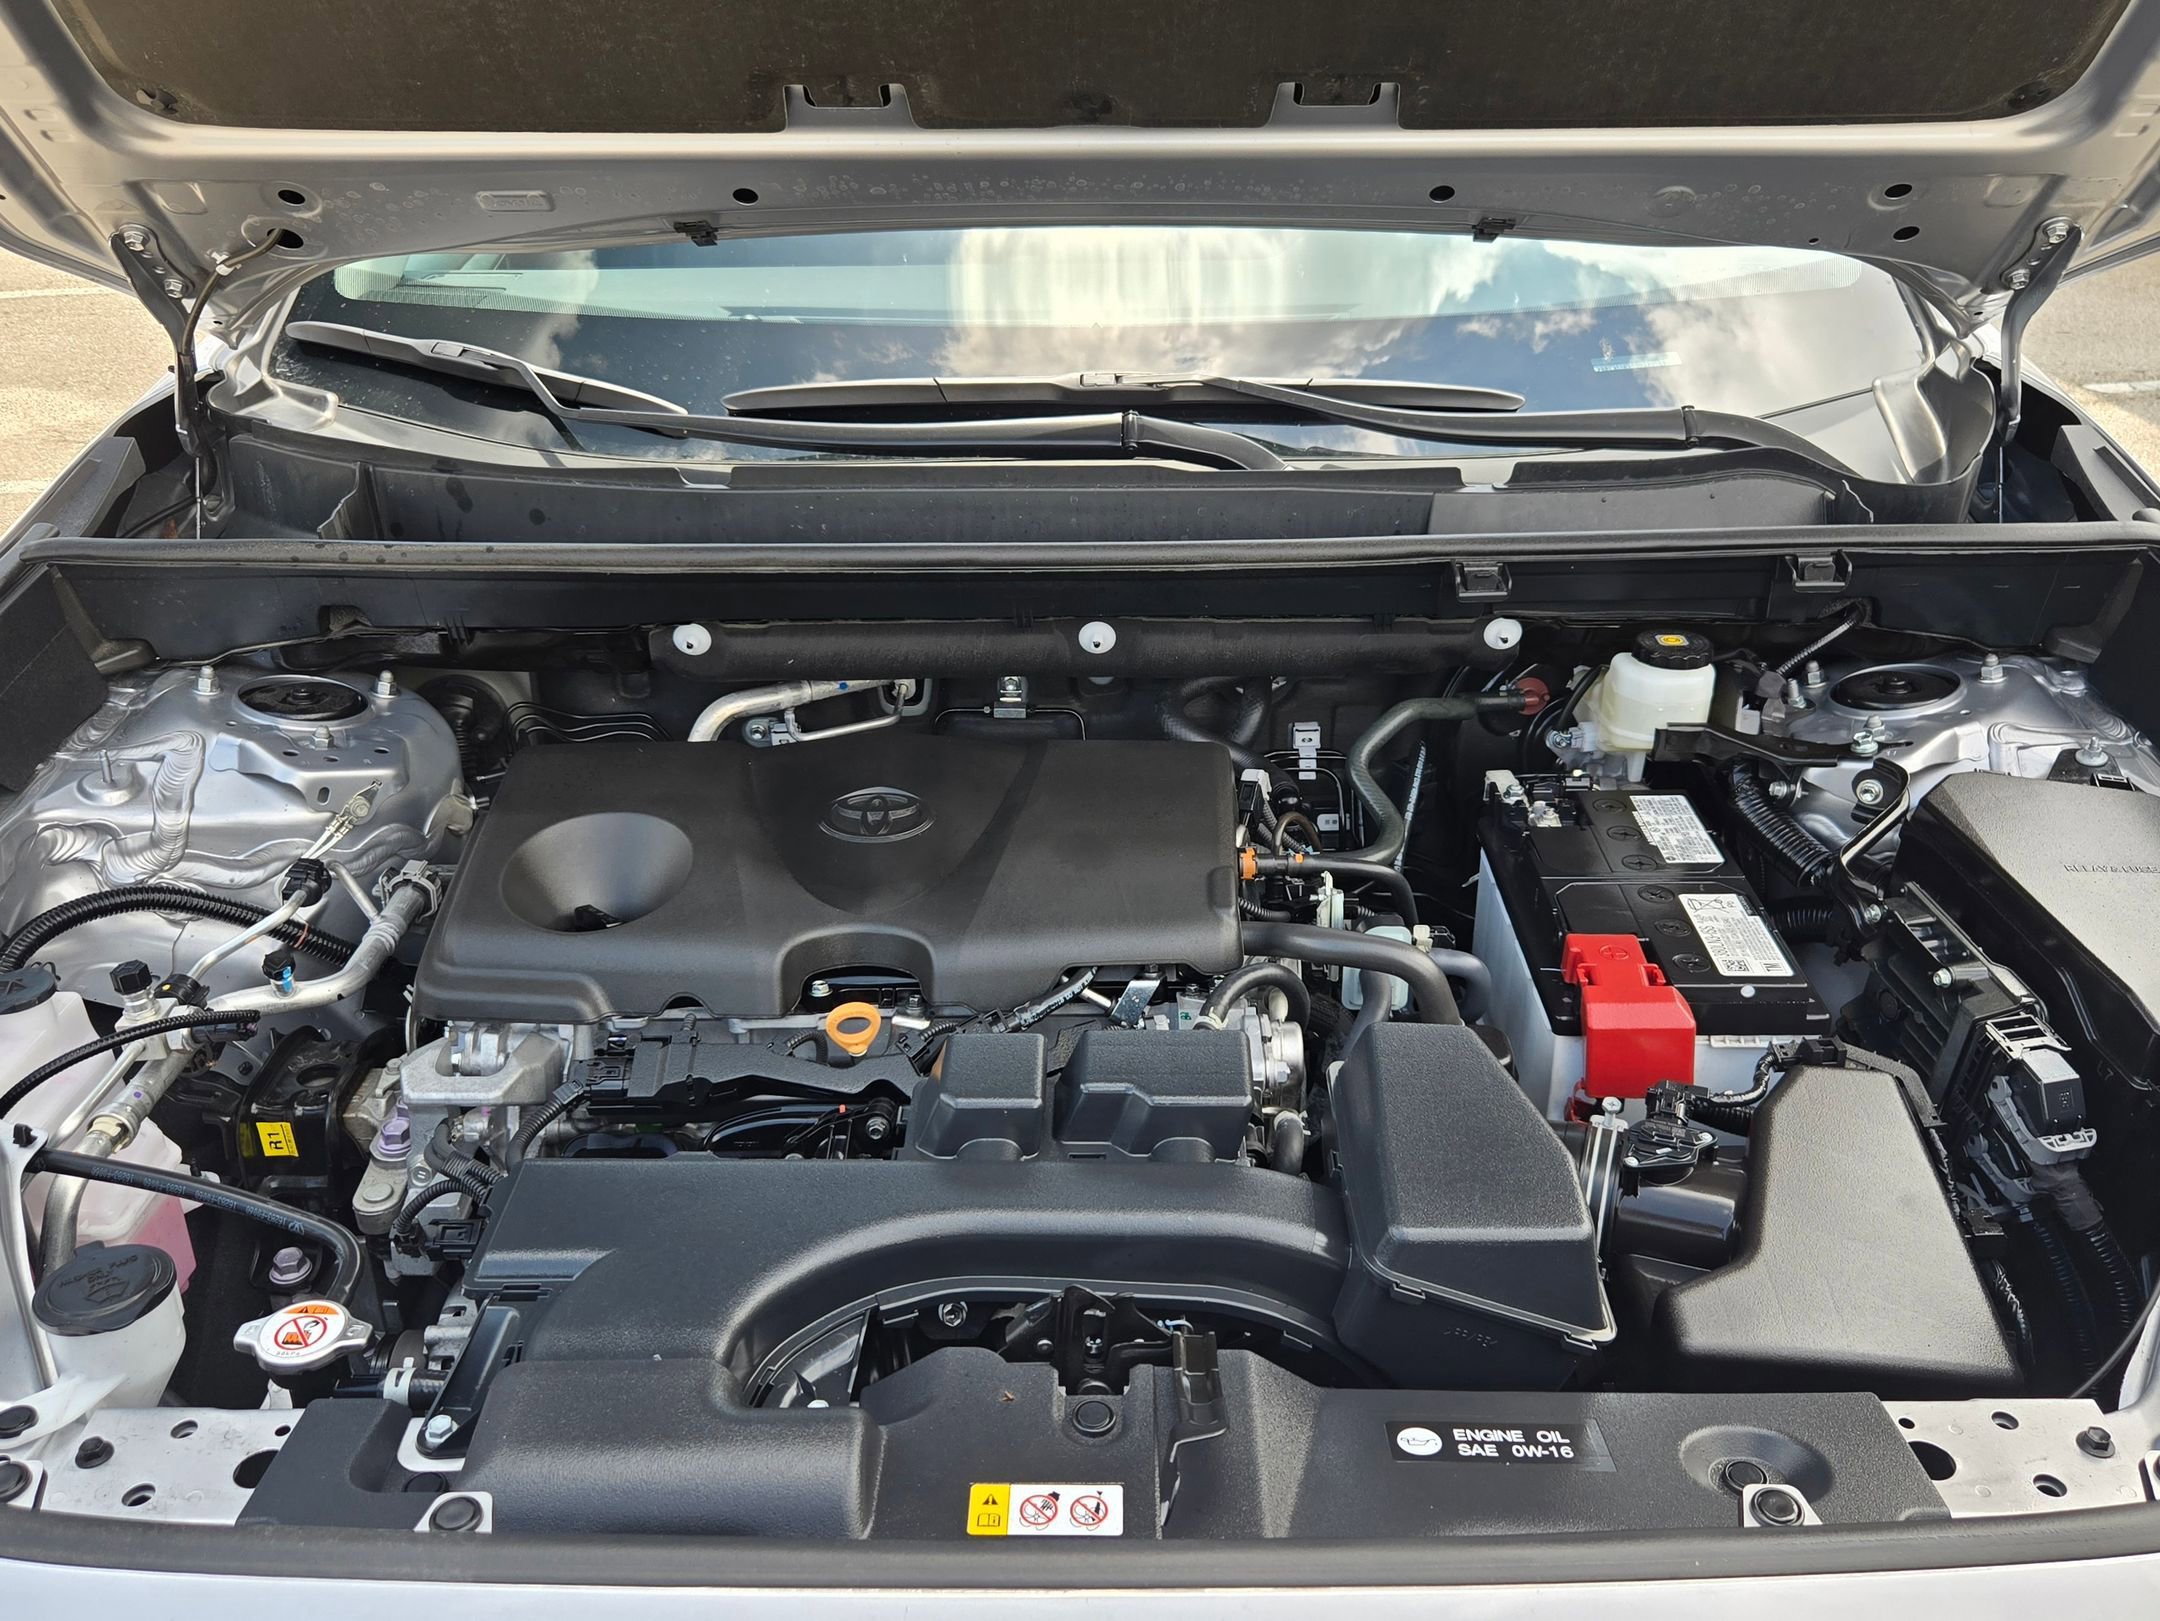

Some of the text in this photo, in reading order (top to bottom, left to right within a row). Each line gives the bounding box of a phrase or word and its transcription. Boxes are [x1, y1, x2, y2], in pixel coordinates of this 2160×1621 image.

[267, 1132, 284, 1150] R1
[1452, 1428, 1570, 1444] ENGINE OIL
[1458, 1443, 1575, 1459] SAE 0W-16
